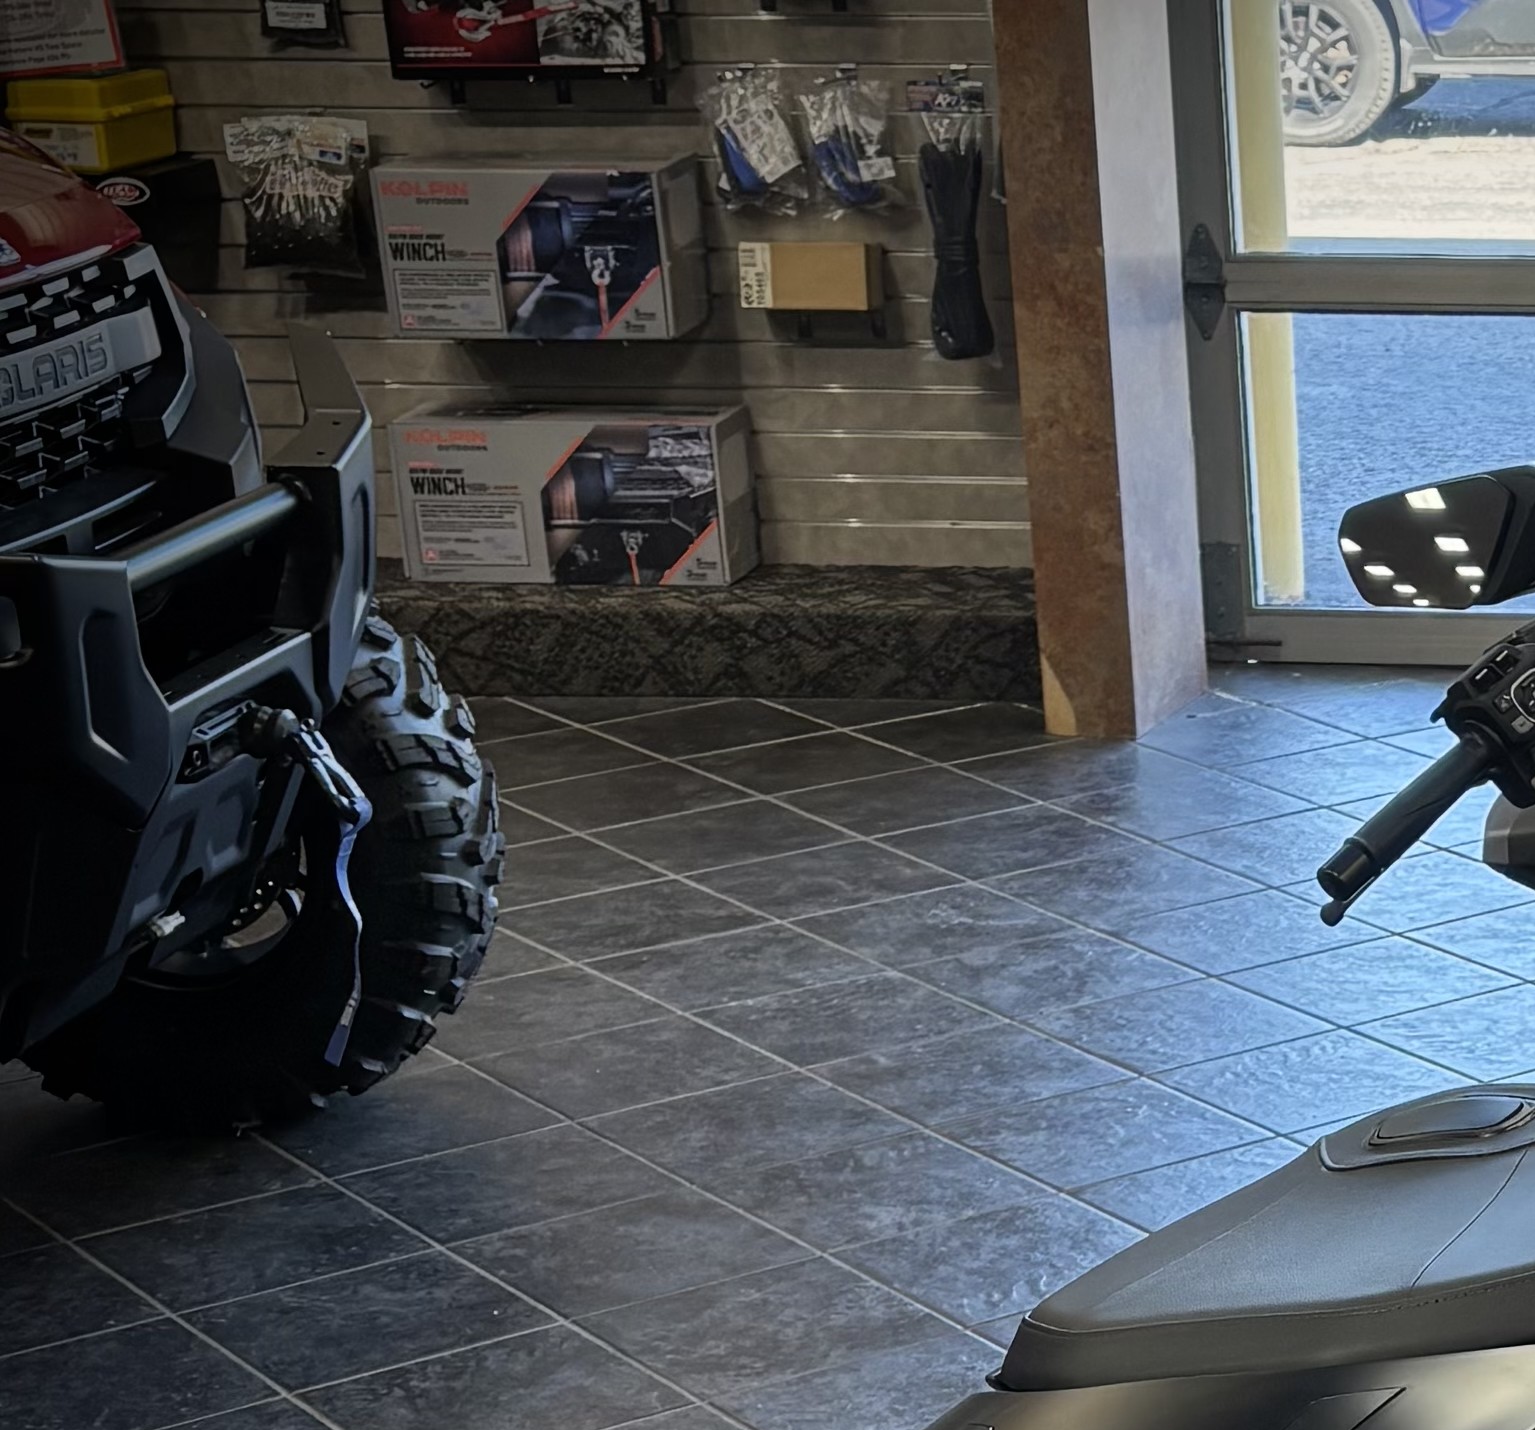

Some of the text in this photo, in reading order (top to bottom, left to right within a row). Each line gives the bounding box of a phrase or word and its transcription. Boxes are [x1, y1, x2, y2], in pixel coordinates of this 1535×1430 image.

[381, 181, 468, 197] KOLPIN
[388, 242, 447, 262] WINCH
[410, 476, 466, 495] WINCH
